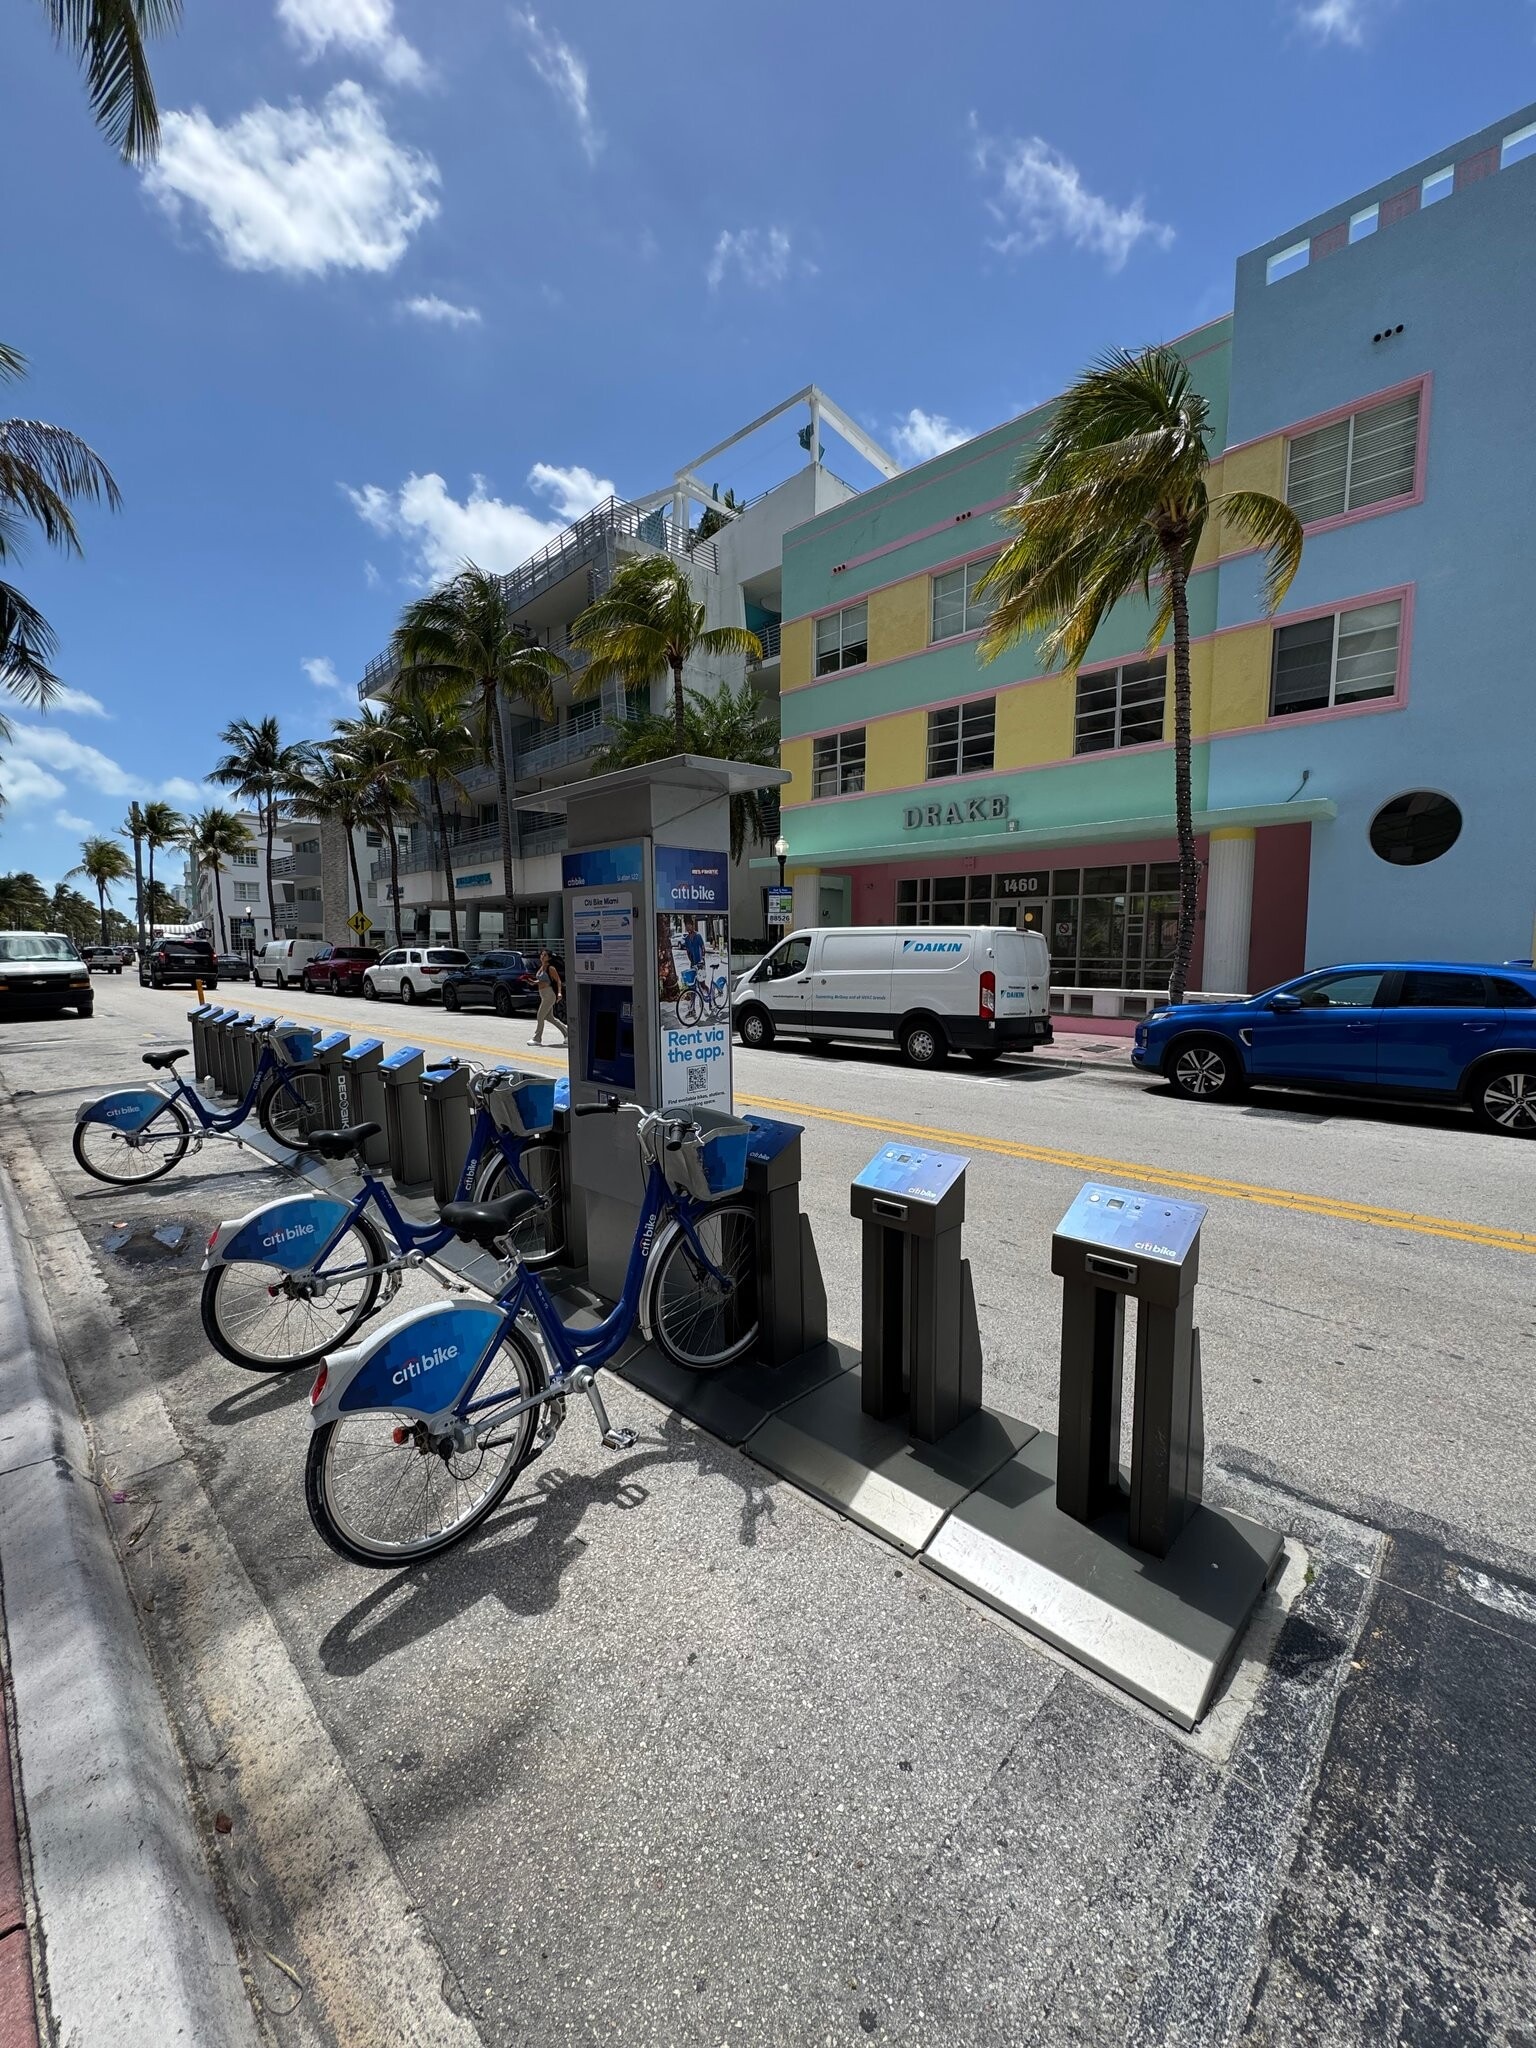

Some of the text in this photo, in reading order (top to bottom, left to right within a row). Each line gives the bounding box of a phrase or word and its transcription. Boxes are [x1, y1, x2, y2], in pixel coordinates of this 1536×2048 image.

[903, 795, 1009, 830] DRAKE
[1003, 878, 1038, 893] 1460
[914, 943, 963, 952] DAIKIN
[668, 1027, 724, 1047] Rent via
[668, 1046, 725, 1063] the app.
[337, 1075, 350, 1130] DECOBIK
